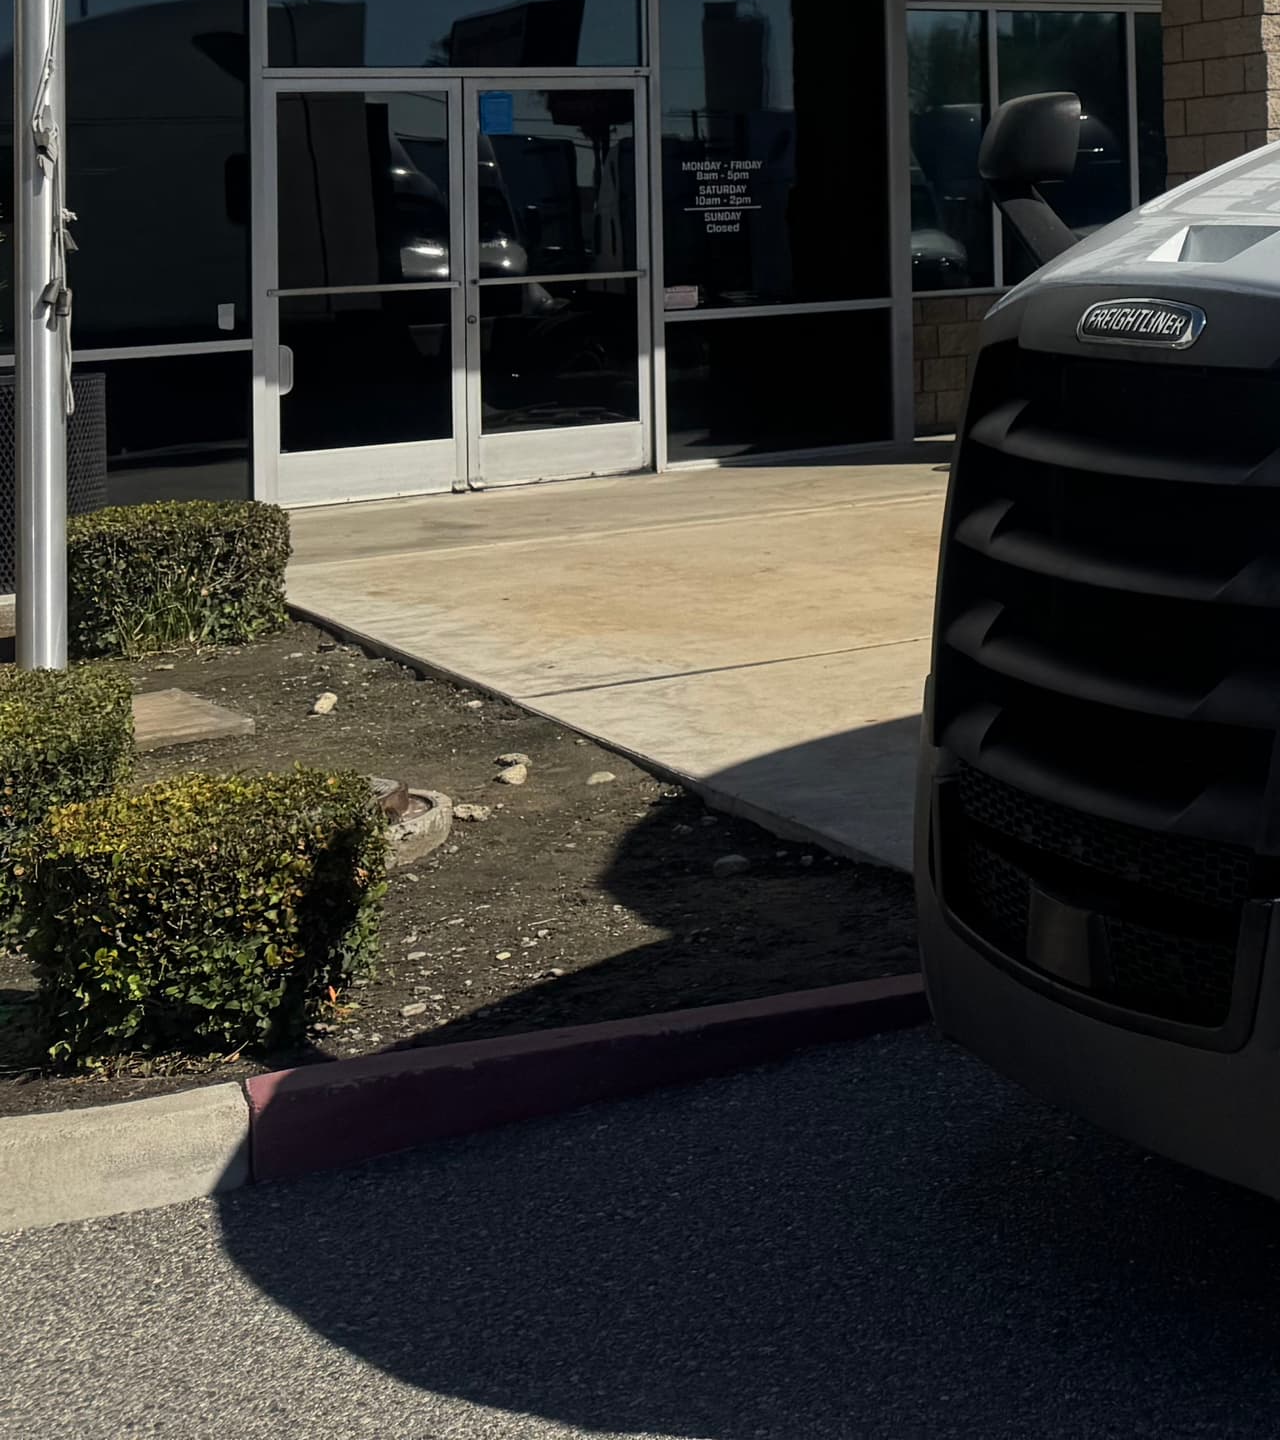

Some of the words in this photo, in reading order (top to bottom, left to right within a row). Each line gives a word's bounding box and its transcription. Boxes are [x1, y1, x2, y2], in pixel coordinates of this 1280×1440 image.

[682, 161, 721, 171] MONDAY
[730, 160, 762, 169] FRIDAY
[696, 171, 718, 180] 8am
[727, 170, 749, 181] 5pm
[699, 184, 747, 195] SATURDAY
[695, 195, 720, 205] 10am
[729, 195, 751, 205] 2pm
[704, 211, 741, 221] SUNDAY
[706, 223, 740, 233] Closed
[1086, 308, 1187, 335] FREIGHTLINER
